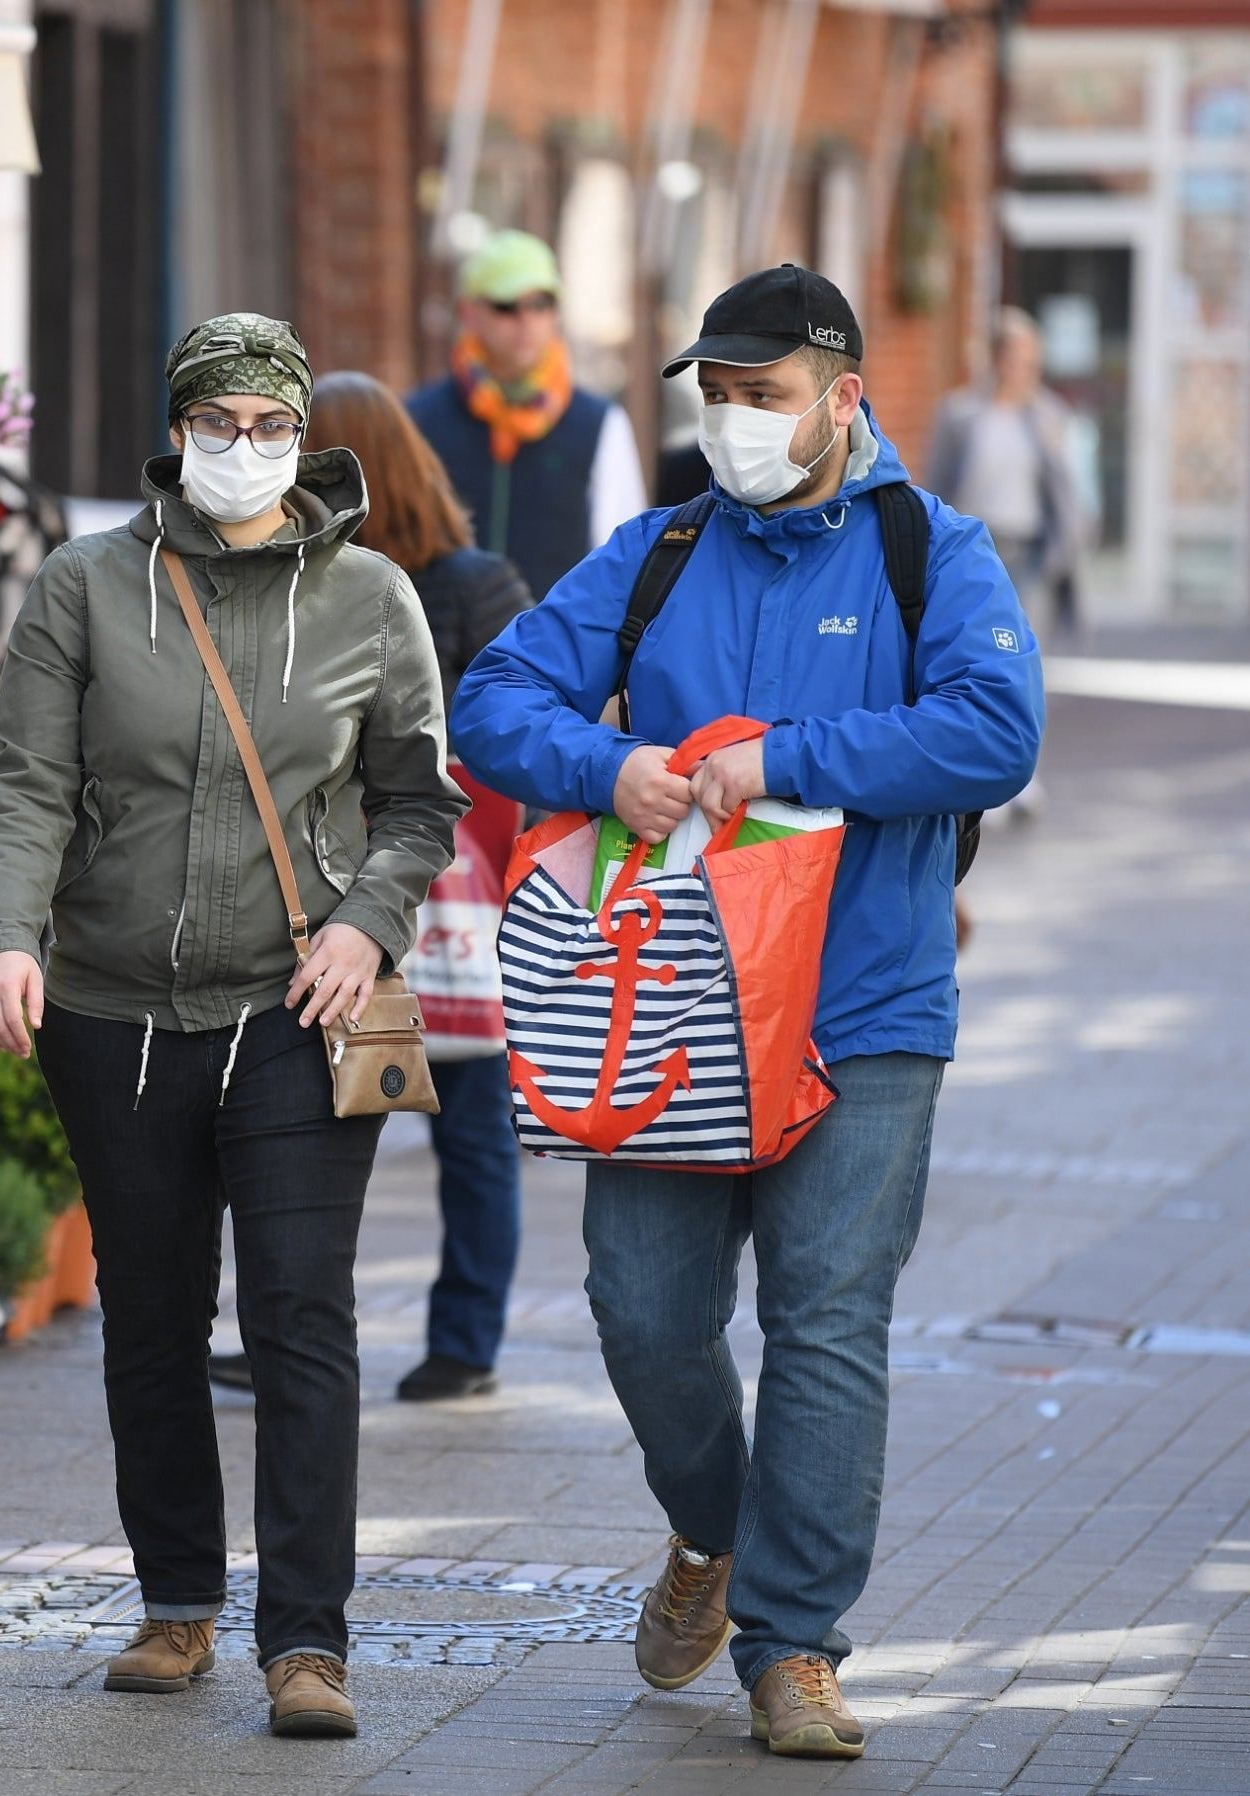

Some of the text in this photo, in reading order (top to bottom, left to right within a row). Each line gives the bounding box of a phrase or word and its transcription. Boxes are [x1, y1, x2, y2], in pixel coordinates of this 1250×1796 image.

[807, 321, 847, 345] Lerbs
[818, 615, 841, 627] Jack
[818, 625, 858, 635] Wolfskin
